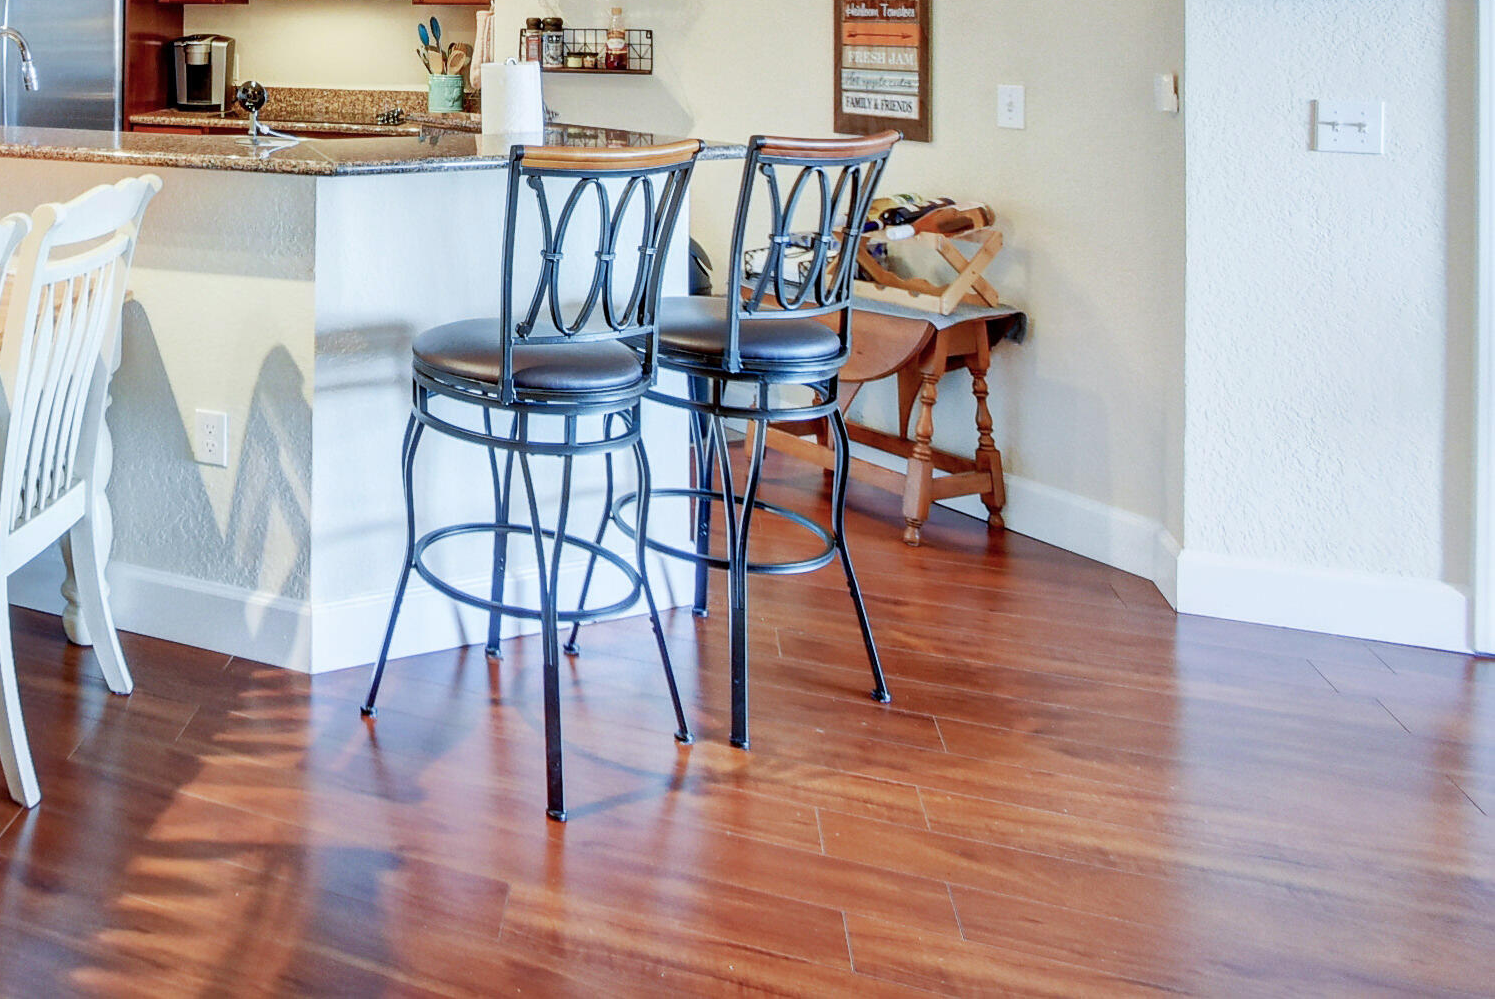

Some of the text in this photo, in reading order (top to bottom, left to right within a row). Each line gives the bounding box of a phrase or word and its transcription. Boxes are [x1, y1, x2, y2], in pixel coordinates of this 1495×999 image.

[848, 50, 914, 66] FRESH JAM
[845, 96, 872, 110] FAMILY
[880, 98, 913, 113] FRIENDS
